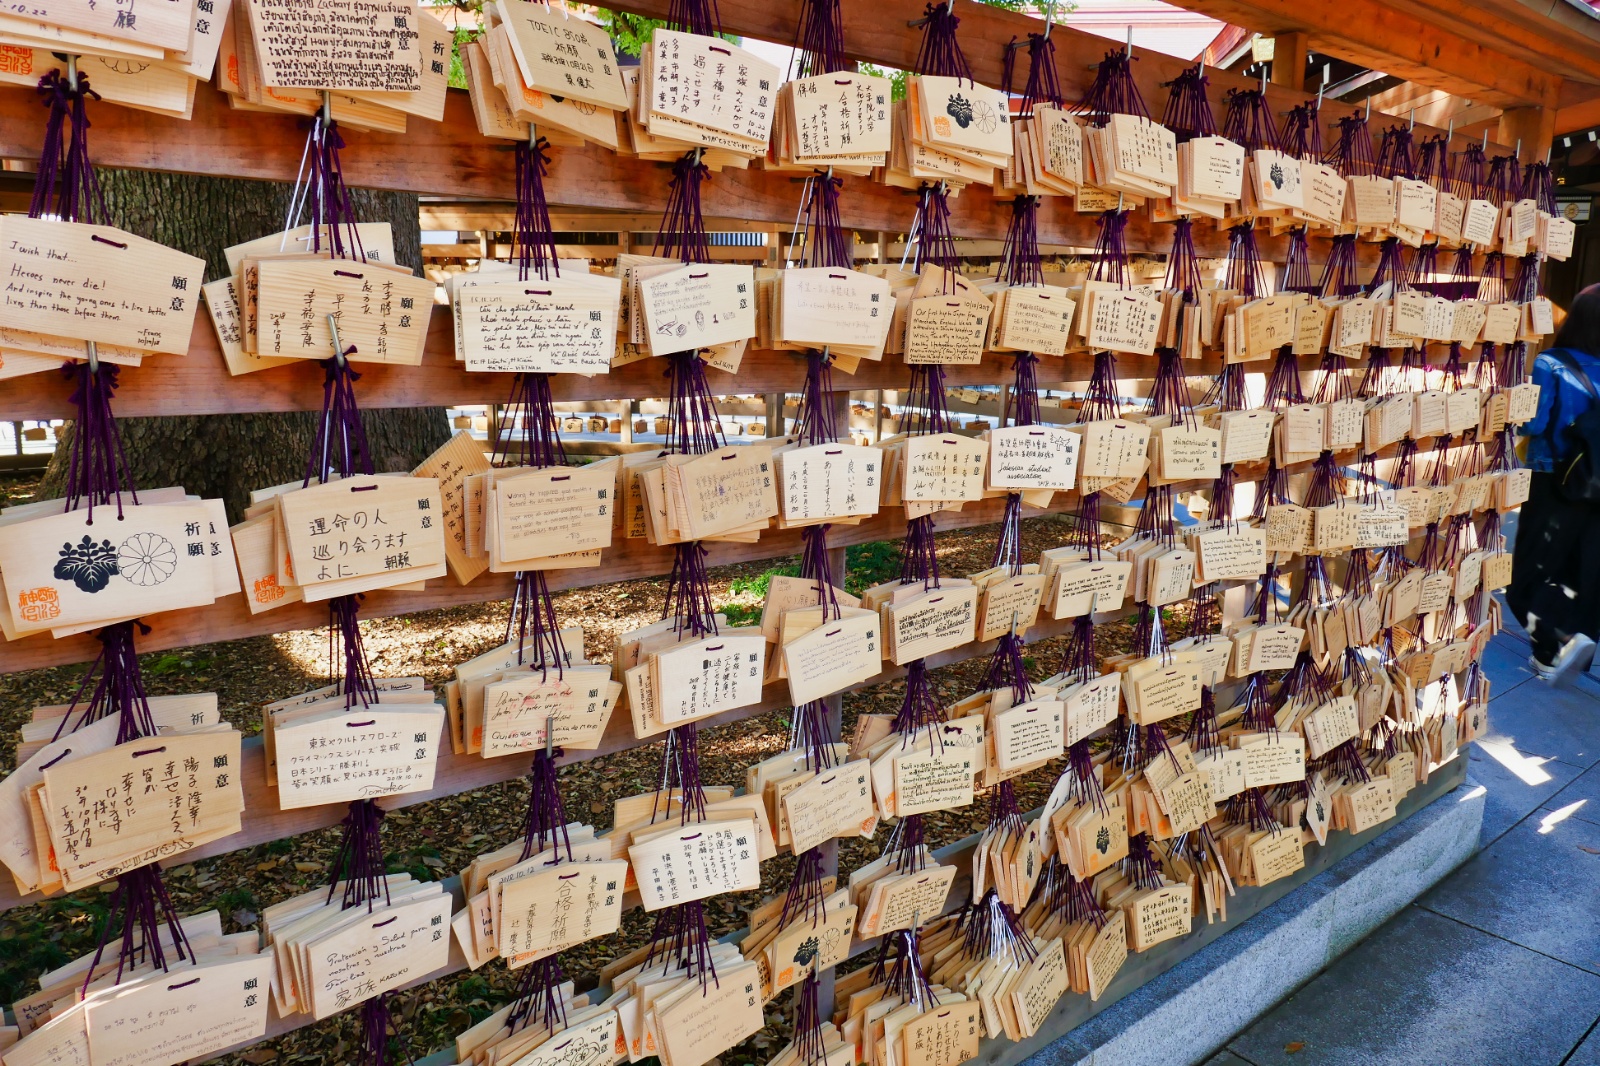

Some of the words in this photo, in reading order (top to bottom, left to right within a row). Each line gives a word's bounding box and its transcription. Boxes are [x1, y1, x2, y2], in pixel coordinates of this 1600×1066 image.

[526, 18, 561, 39] TOEIC
[431, 41, 445, 75] 祈願
[598, 47, 612, 76] 願意
[758, 79, 770, 108] 願意
[876, 95, 885, 120] 願意
[9, 240, 16, 250] I
[18, 245, 40, 255] wish
[5, 282, 24, 294] And
[10, 263, 44, 282] Heroes
[52, 276, 75, 286] never
[170, 275, 188, 312] 願意
[737, 282, 748, 310] 願意
[869, 292, 881, 318] 願意
[399, 297, 414, 328] 願意
[589, 310, 602, 339] 願意
[760, 462, 770, 488] 願意
[865, 463, 875, 487] 願意
[974, 454, 982, 476] 願意
[417, 497, 433, 530] 願意
[597, 489, 607, 516] 願意
[309, 508, 389, 537] 運命の人
[185, 521, 205, 557] 祈願
[866, 630, 875, 653] 願意
[749, 652, 758, 678] 願意
[587, 687, 600, 714] 願意
[413, 731, 427, 761] 願意
[213, 753, 230, 789] 願意
[121, 772, 137, 817] 幸せに
[736, 835, 750, 861] 願意
[604, 880, 617, 907] 願意
[549, 880, 577, 944] 合格祈願
[430, 913, 443, 943] 願意
[244, 976, 258, 1008] 願意
[744, 982, 754, 1008] 願意
